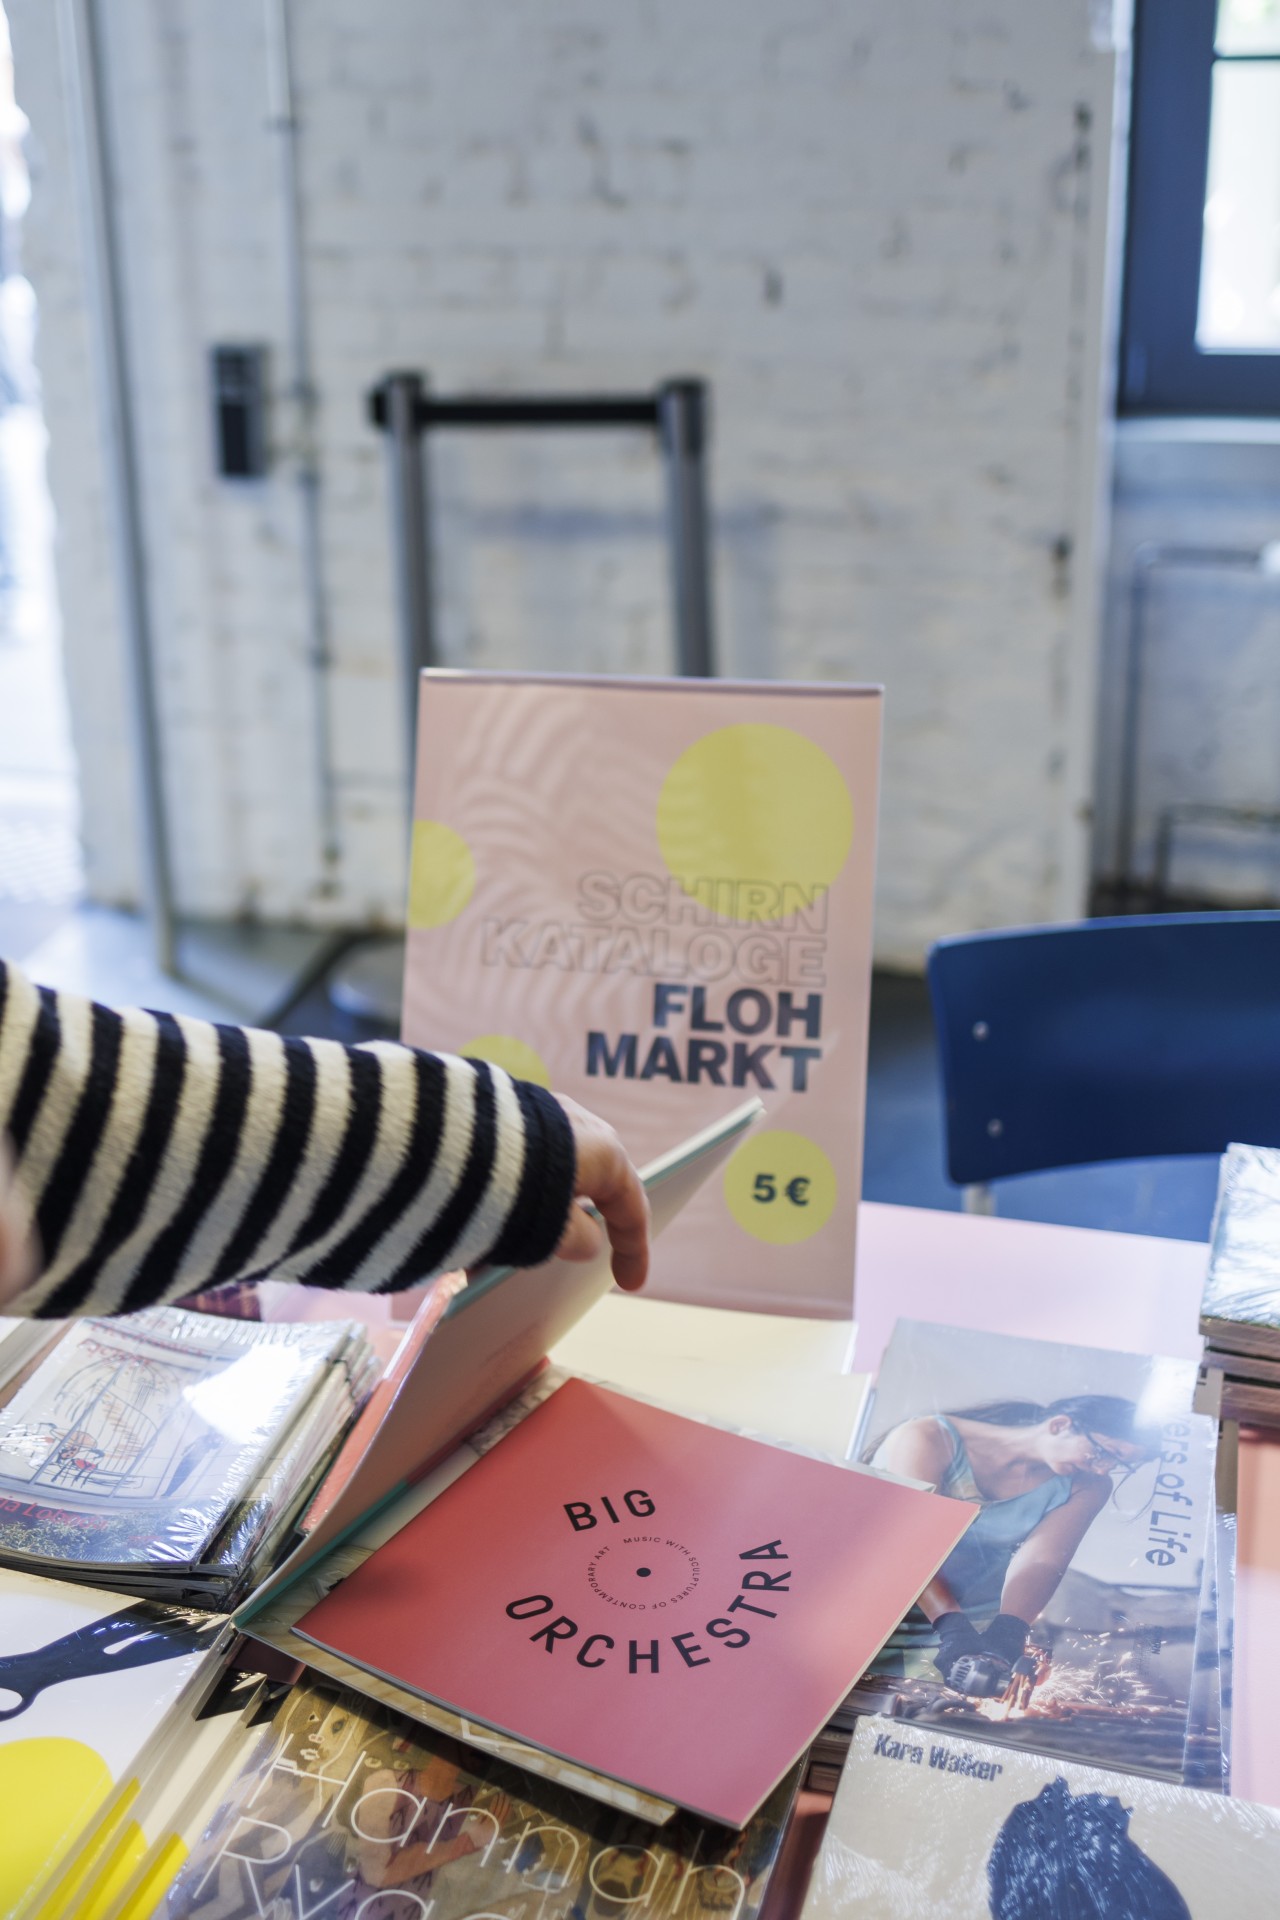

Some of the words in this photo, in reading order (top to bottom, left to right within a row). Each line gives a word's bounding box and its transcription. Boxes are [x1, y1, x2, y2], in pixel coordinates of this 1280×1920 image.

[578, 871, 829, 933] SCHIRN
[481, 919, 827, 987] KATALOGE
[653, 983, 822, 1039] FLOH
[585, 1031, 822, 1093] MARKT
[752, 1174, 775, 1203] 5
[785, 1177, 810, 1206] €
[563, 1489, 656, 1532] BIG
[1156, 1473, 1193, 1506] of
[595, 1545, 611, 1560] ART
[623, 1536, 661, 1544] MUSIC
[666, 1540, 691, 1556] WITH
[1145, 1510, 1192, 1567] Life
[587, 1561, 646, 1610] CONTEMPORARY
[671, 1556, 700, 1603] SCULPTURES
[505, 1539, 791, 1674] ORCHESTRA
[652, 1601, 667, 1610] OF
[873, 1733, 924, 1765] Kara
[928, 1745, 1003, 1782] Walker
